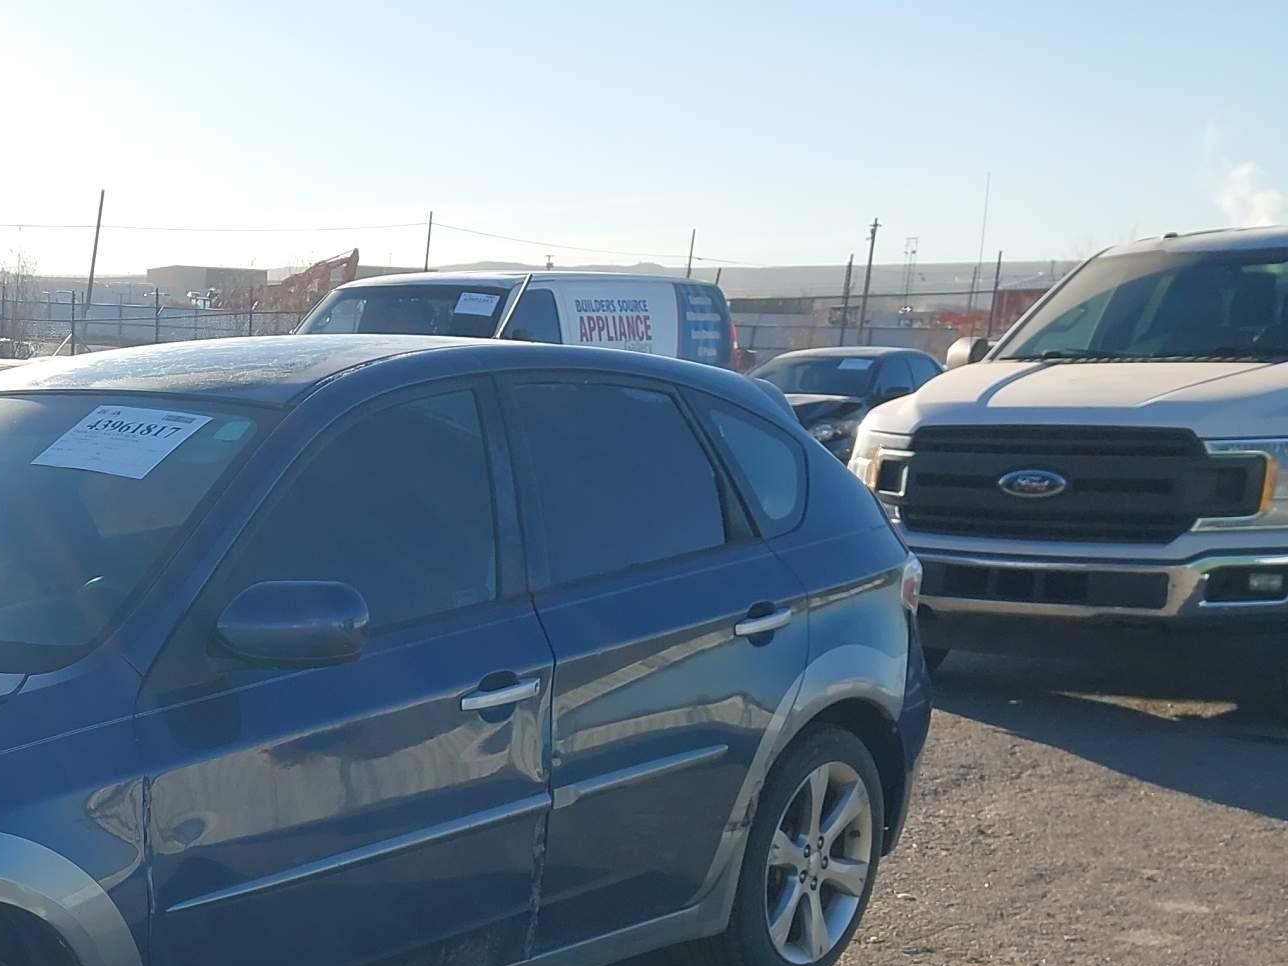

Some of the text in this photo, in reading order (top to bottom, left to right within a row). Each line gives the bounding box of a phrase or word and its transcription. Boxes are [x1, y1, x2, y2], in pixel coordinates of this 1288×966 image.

[576, 299, 649, 313] BUILDERS SOURCE
[579, 314, 652, 342] APPLIANCE
[87, 418, 182, 440] 43961817
